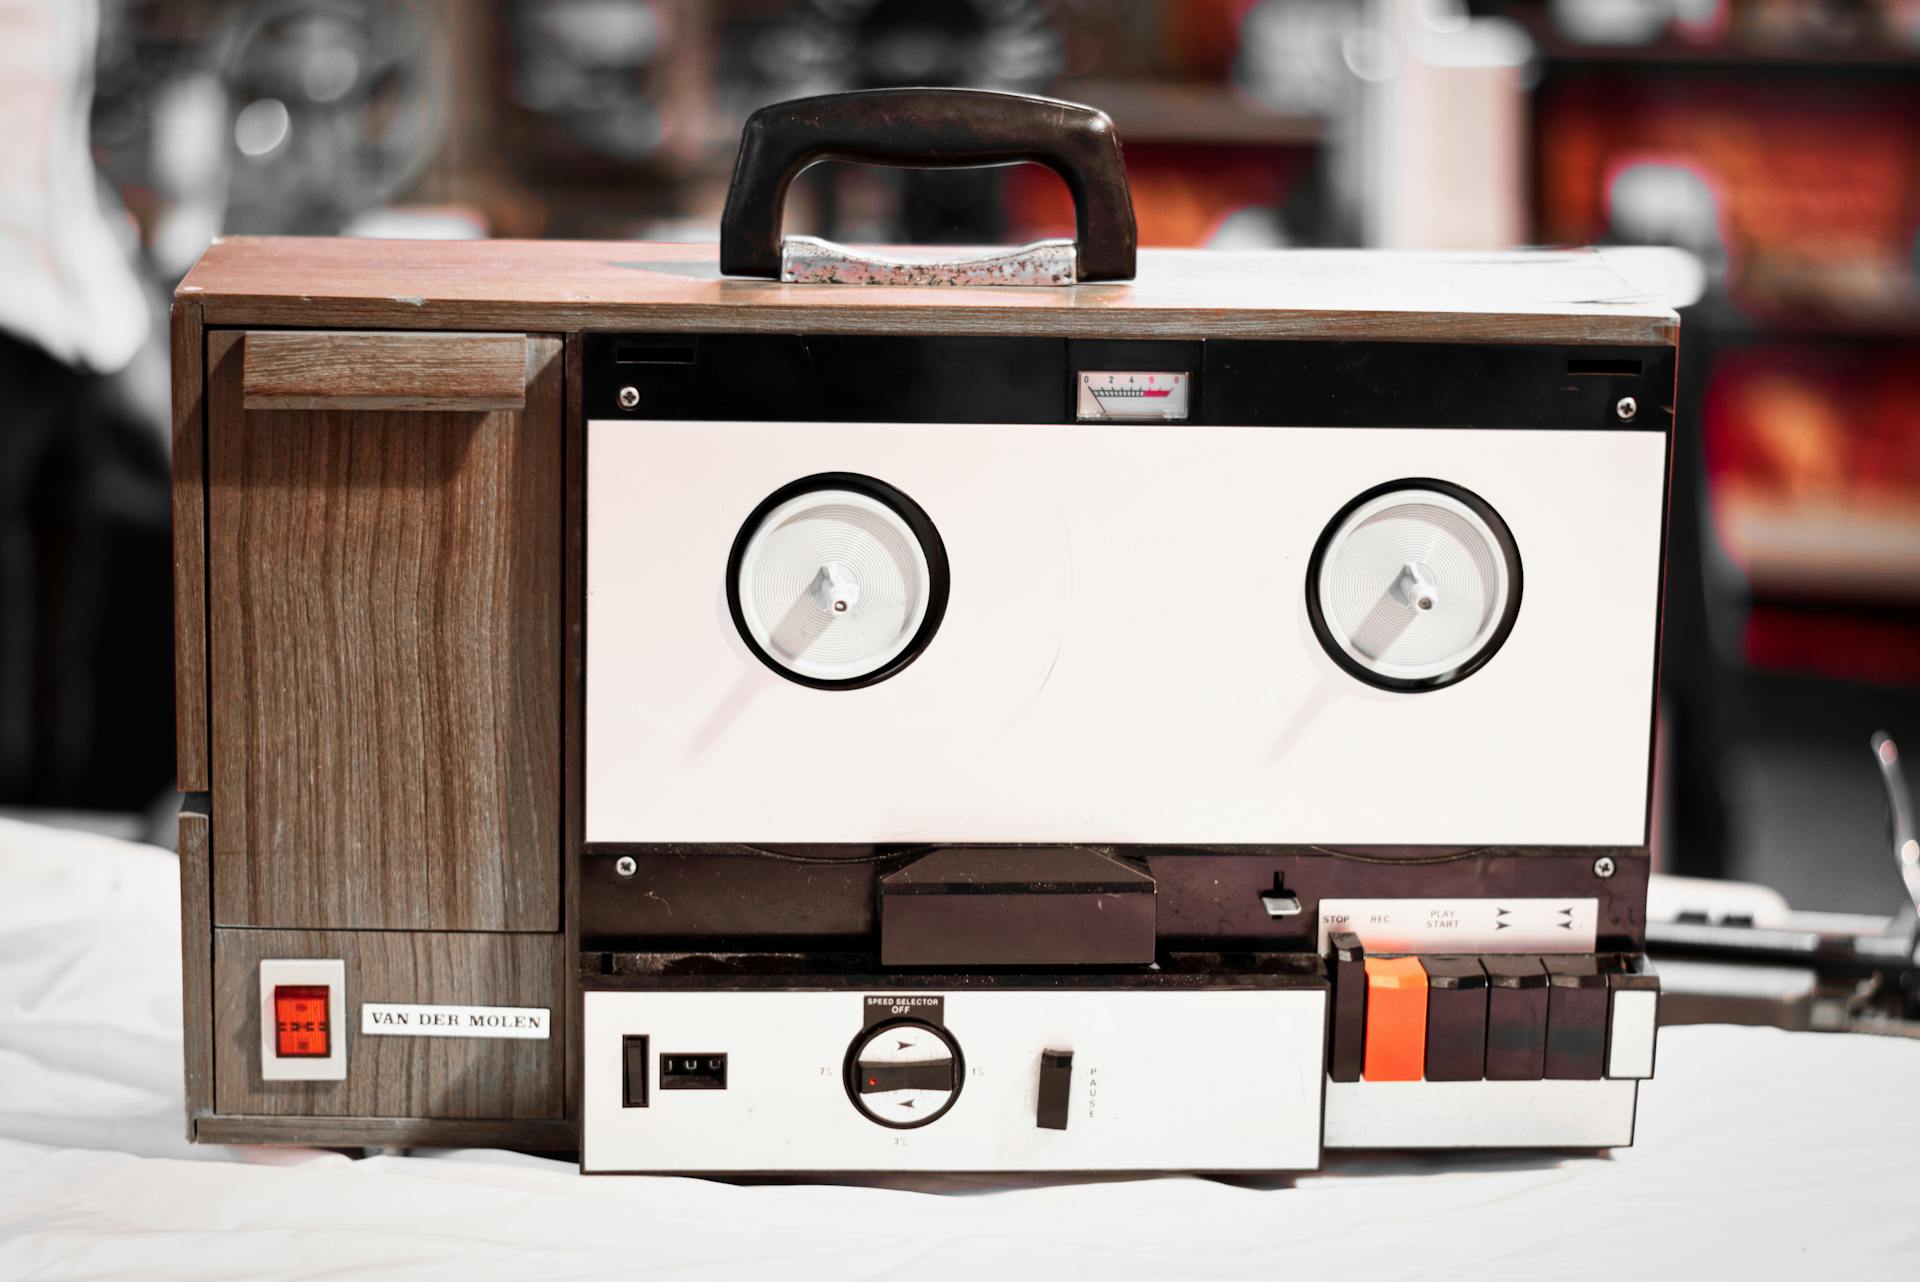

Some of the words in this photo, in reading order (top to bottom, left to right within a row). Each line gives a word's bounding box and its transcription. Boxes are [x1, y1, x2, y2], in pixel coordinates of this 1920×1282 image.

[1430, 910, 1455, 919] PLAY
[1323, 915, 1350, 924] STOP
[1426, 920, 1460, 929] START
[867, 998, 894, 1006] SPEED
[896, 998, 939, 1006] SELECTOR
[891, 1006, 911, 1014] OFF
[371, 1012, 410, 1025] VAN
[419, 1013, 459, 1026] DER
[469, 1015, 541, 1029] MOLEN
